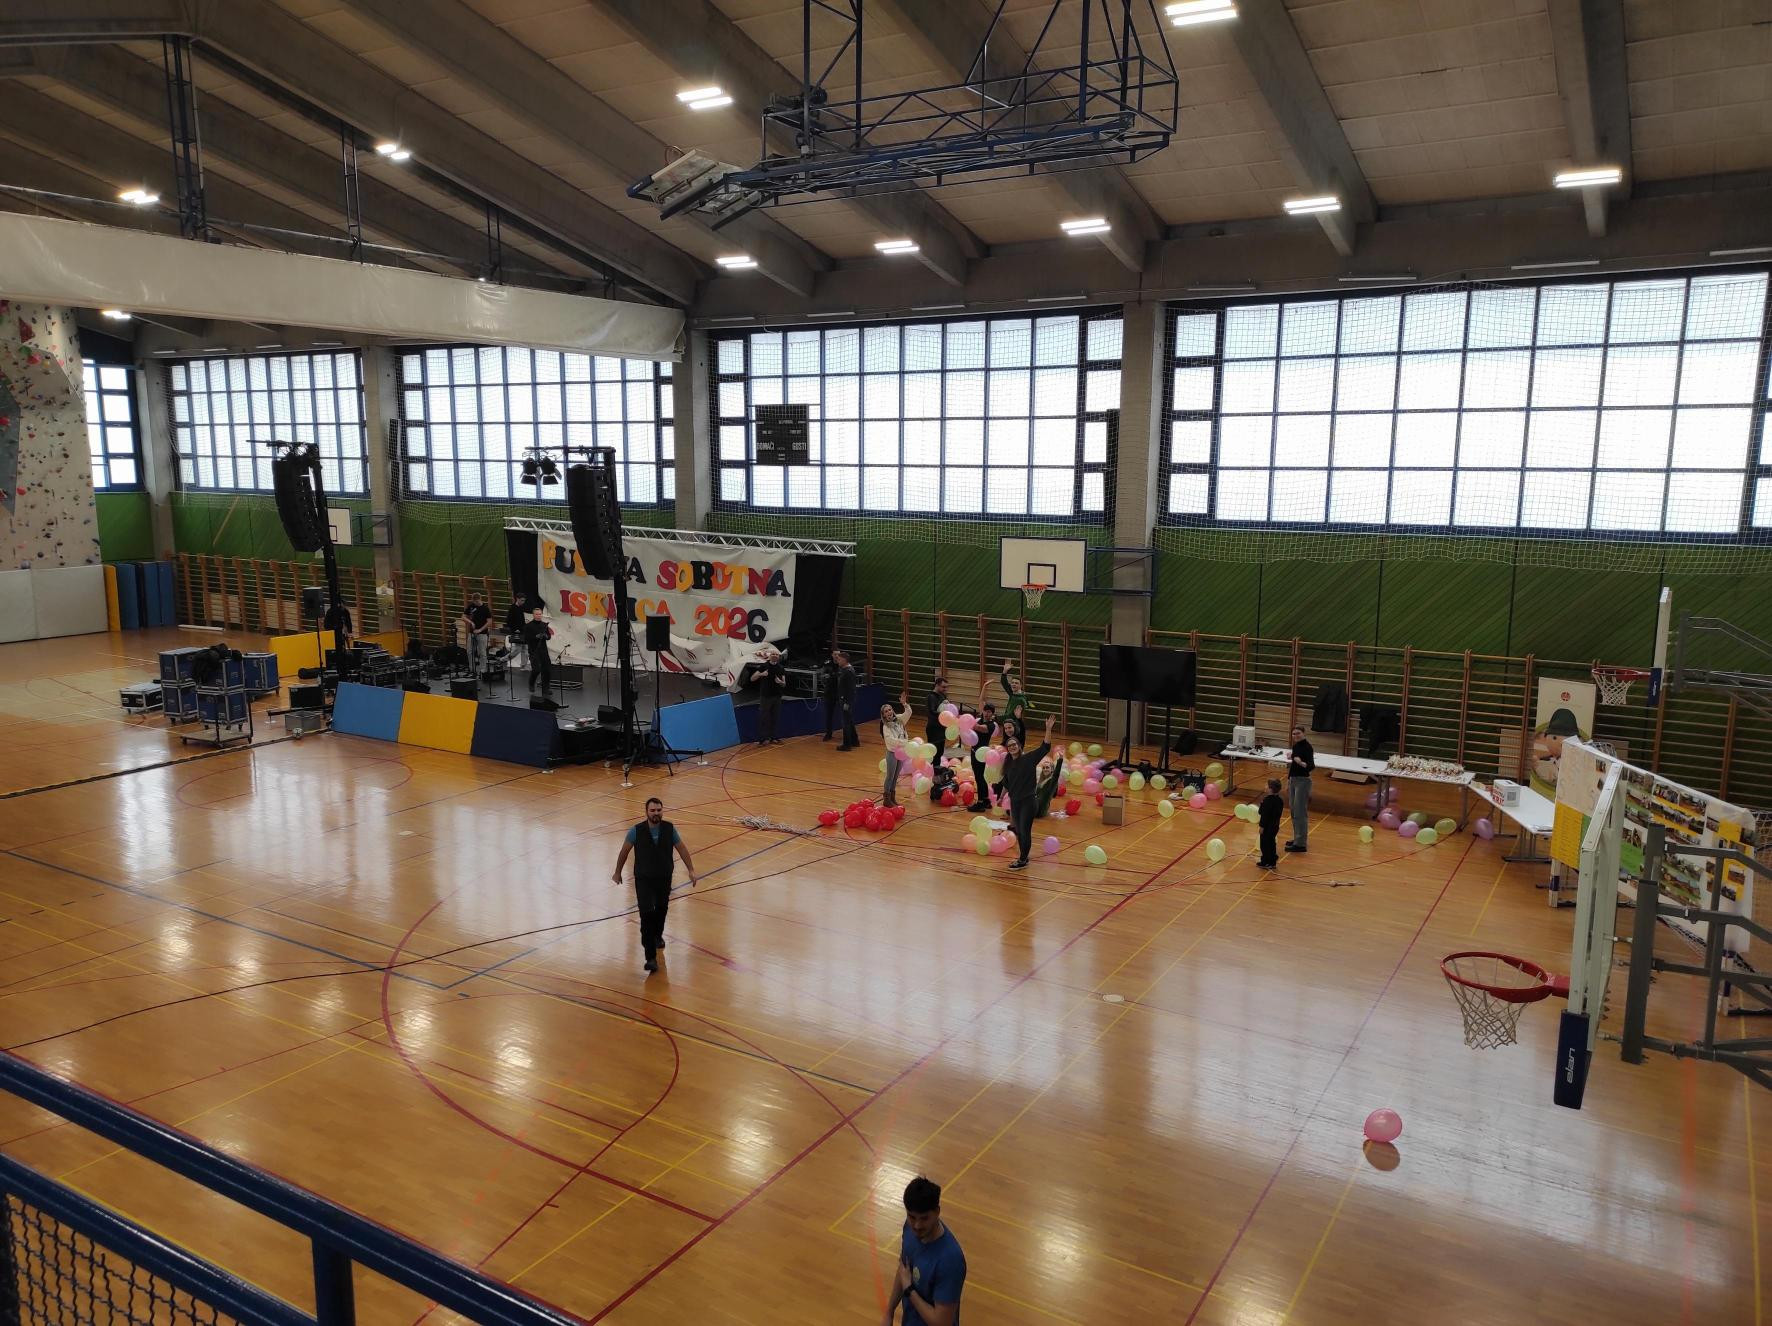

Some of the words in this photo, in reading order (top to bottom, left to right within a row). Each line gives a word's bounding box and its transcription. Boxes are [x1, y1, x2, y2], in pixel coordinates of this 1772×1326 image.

[656, 559, 791, 597] SOBOTNA
[694, 604, 769, 643] 2026
[1565, 1047, 1576, 1084] elan
